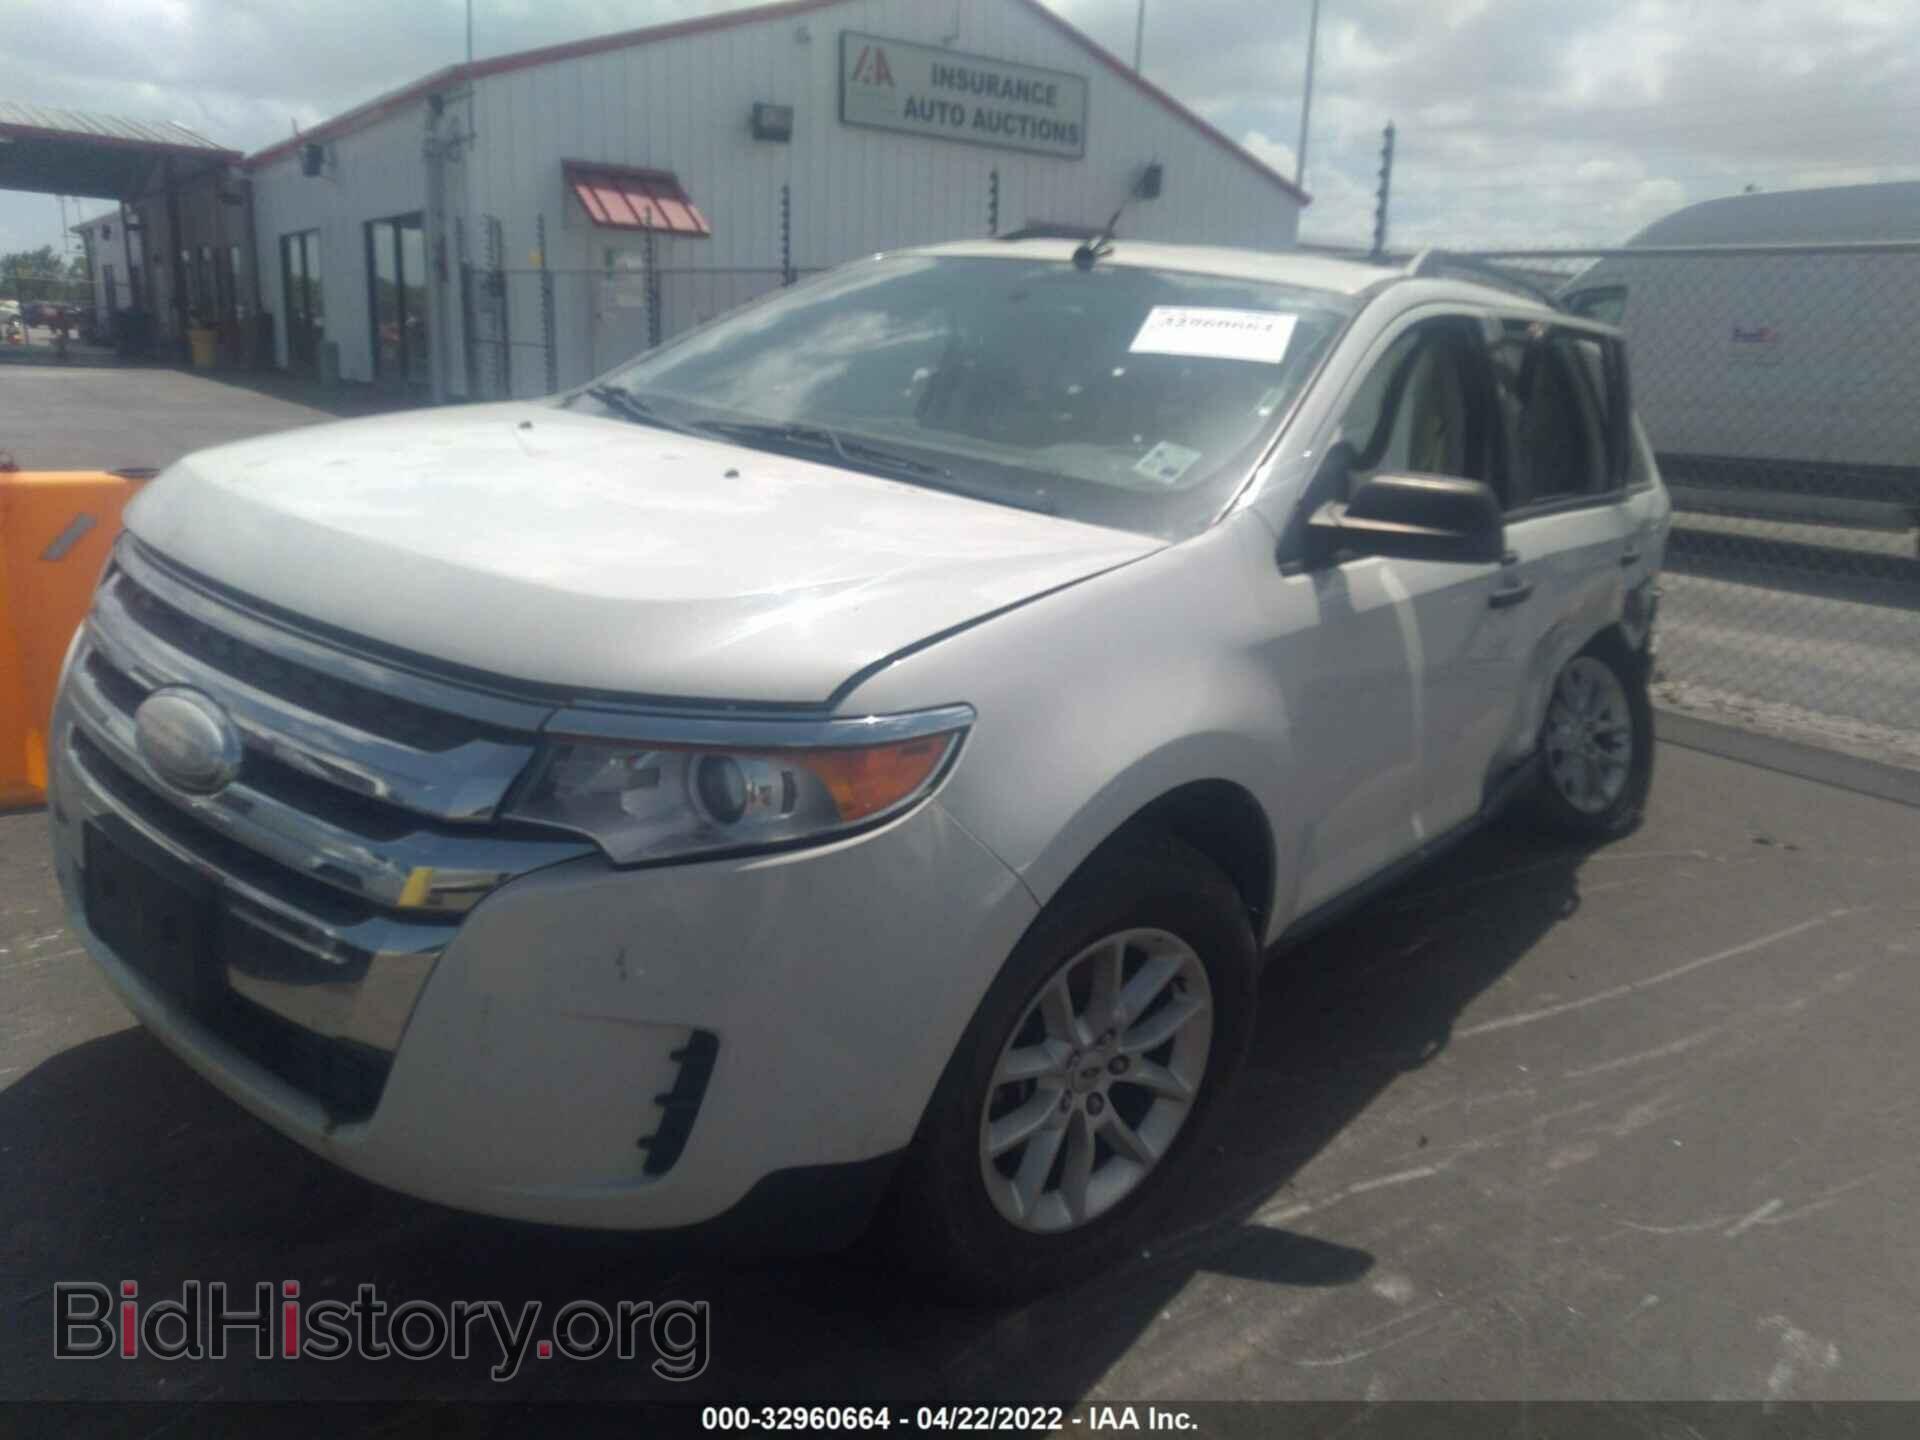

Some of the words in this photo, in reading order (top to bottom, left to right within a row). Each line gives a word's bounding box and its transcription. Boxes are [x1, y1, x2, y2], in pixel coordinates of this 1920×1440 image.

[931, 63, 1058, 107] INSURANCE
[904, 97, 966, 127] AUTO
[973, 107, 1082, 147] AUCTIONS
